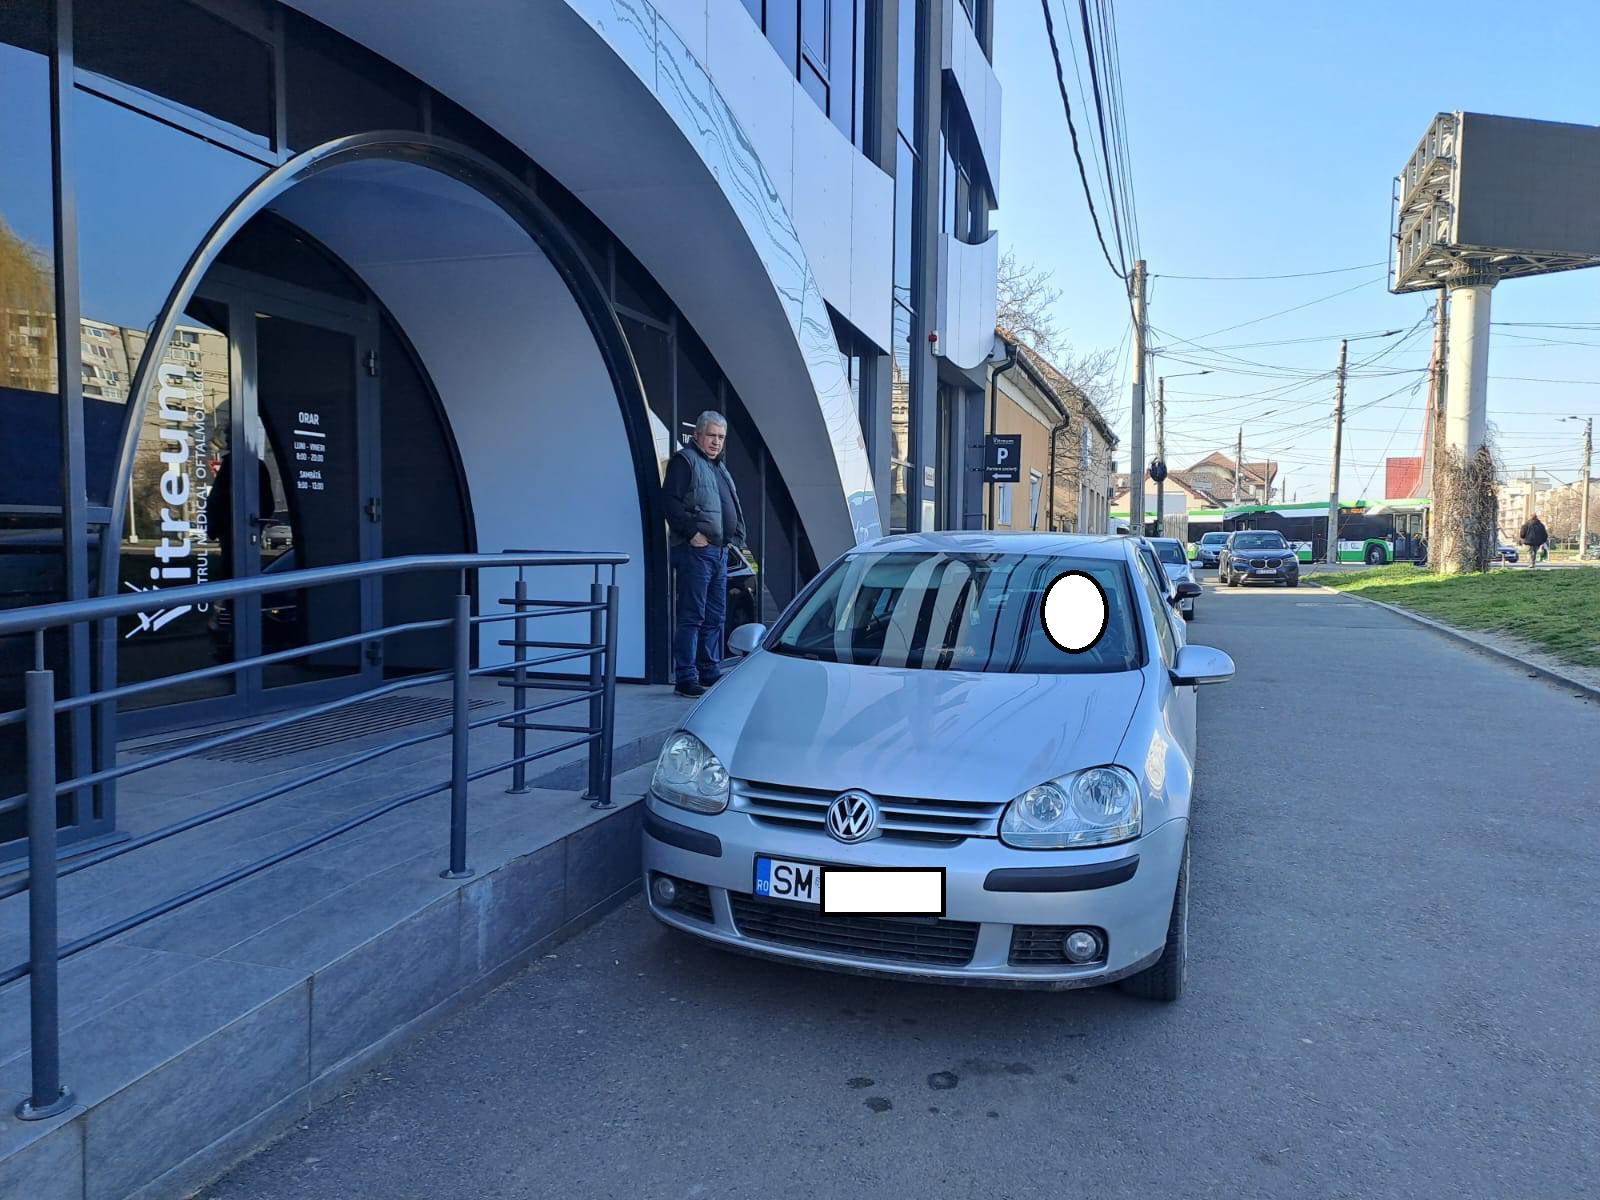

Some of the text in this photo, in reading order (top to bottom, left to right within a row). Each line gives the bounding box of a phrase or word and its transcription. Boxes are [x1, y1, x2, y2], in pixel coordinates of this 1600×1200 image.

[298, 411, 320, 425] ORAR
[997, 447, 1009, 465] P
[196, 482, 209, 546] MEDICAL
[197, 549, 210, 613] CTRUL
[757, 879, 769, 892] RO
[773, 865, 814, 899] SM
